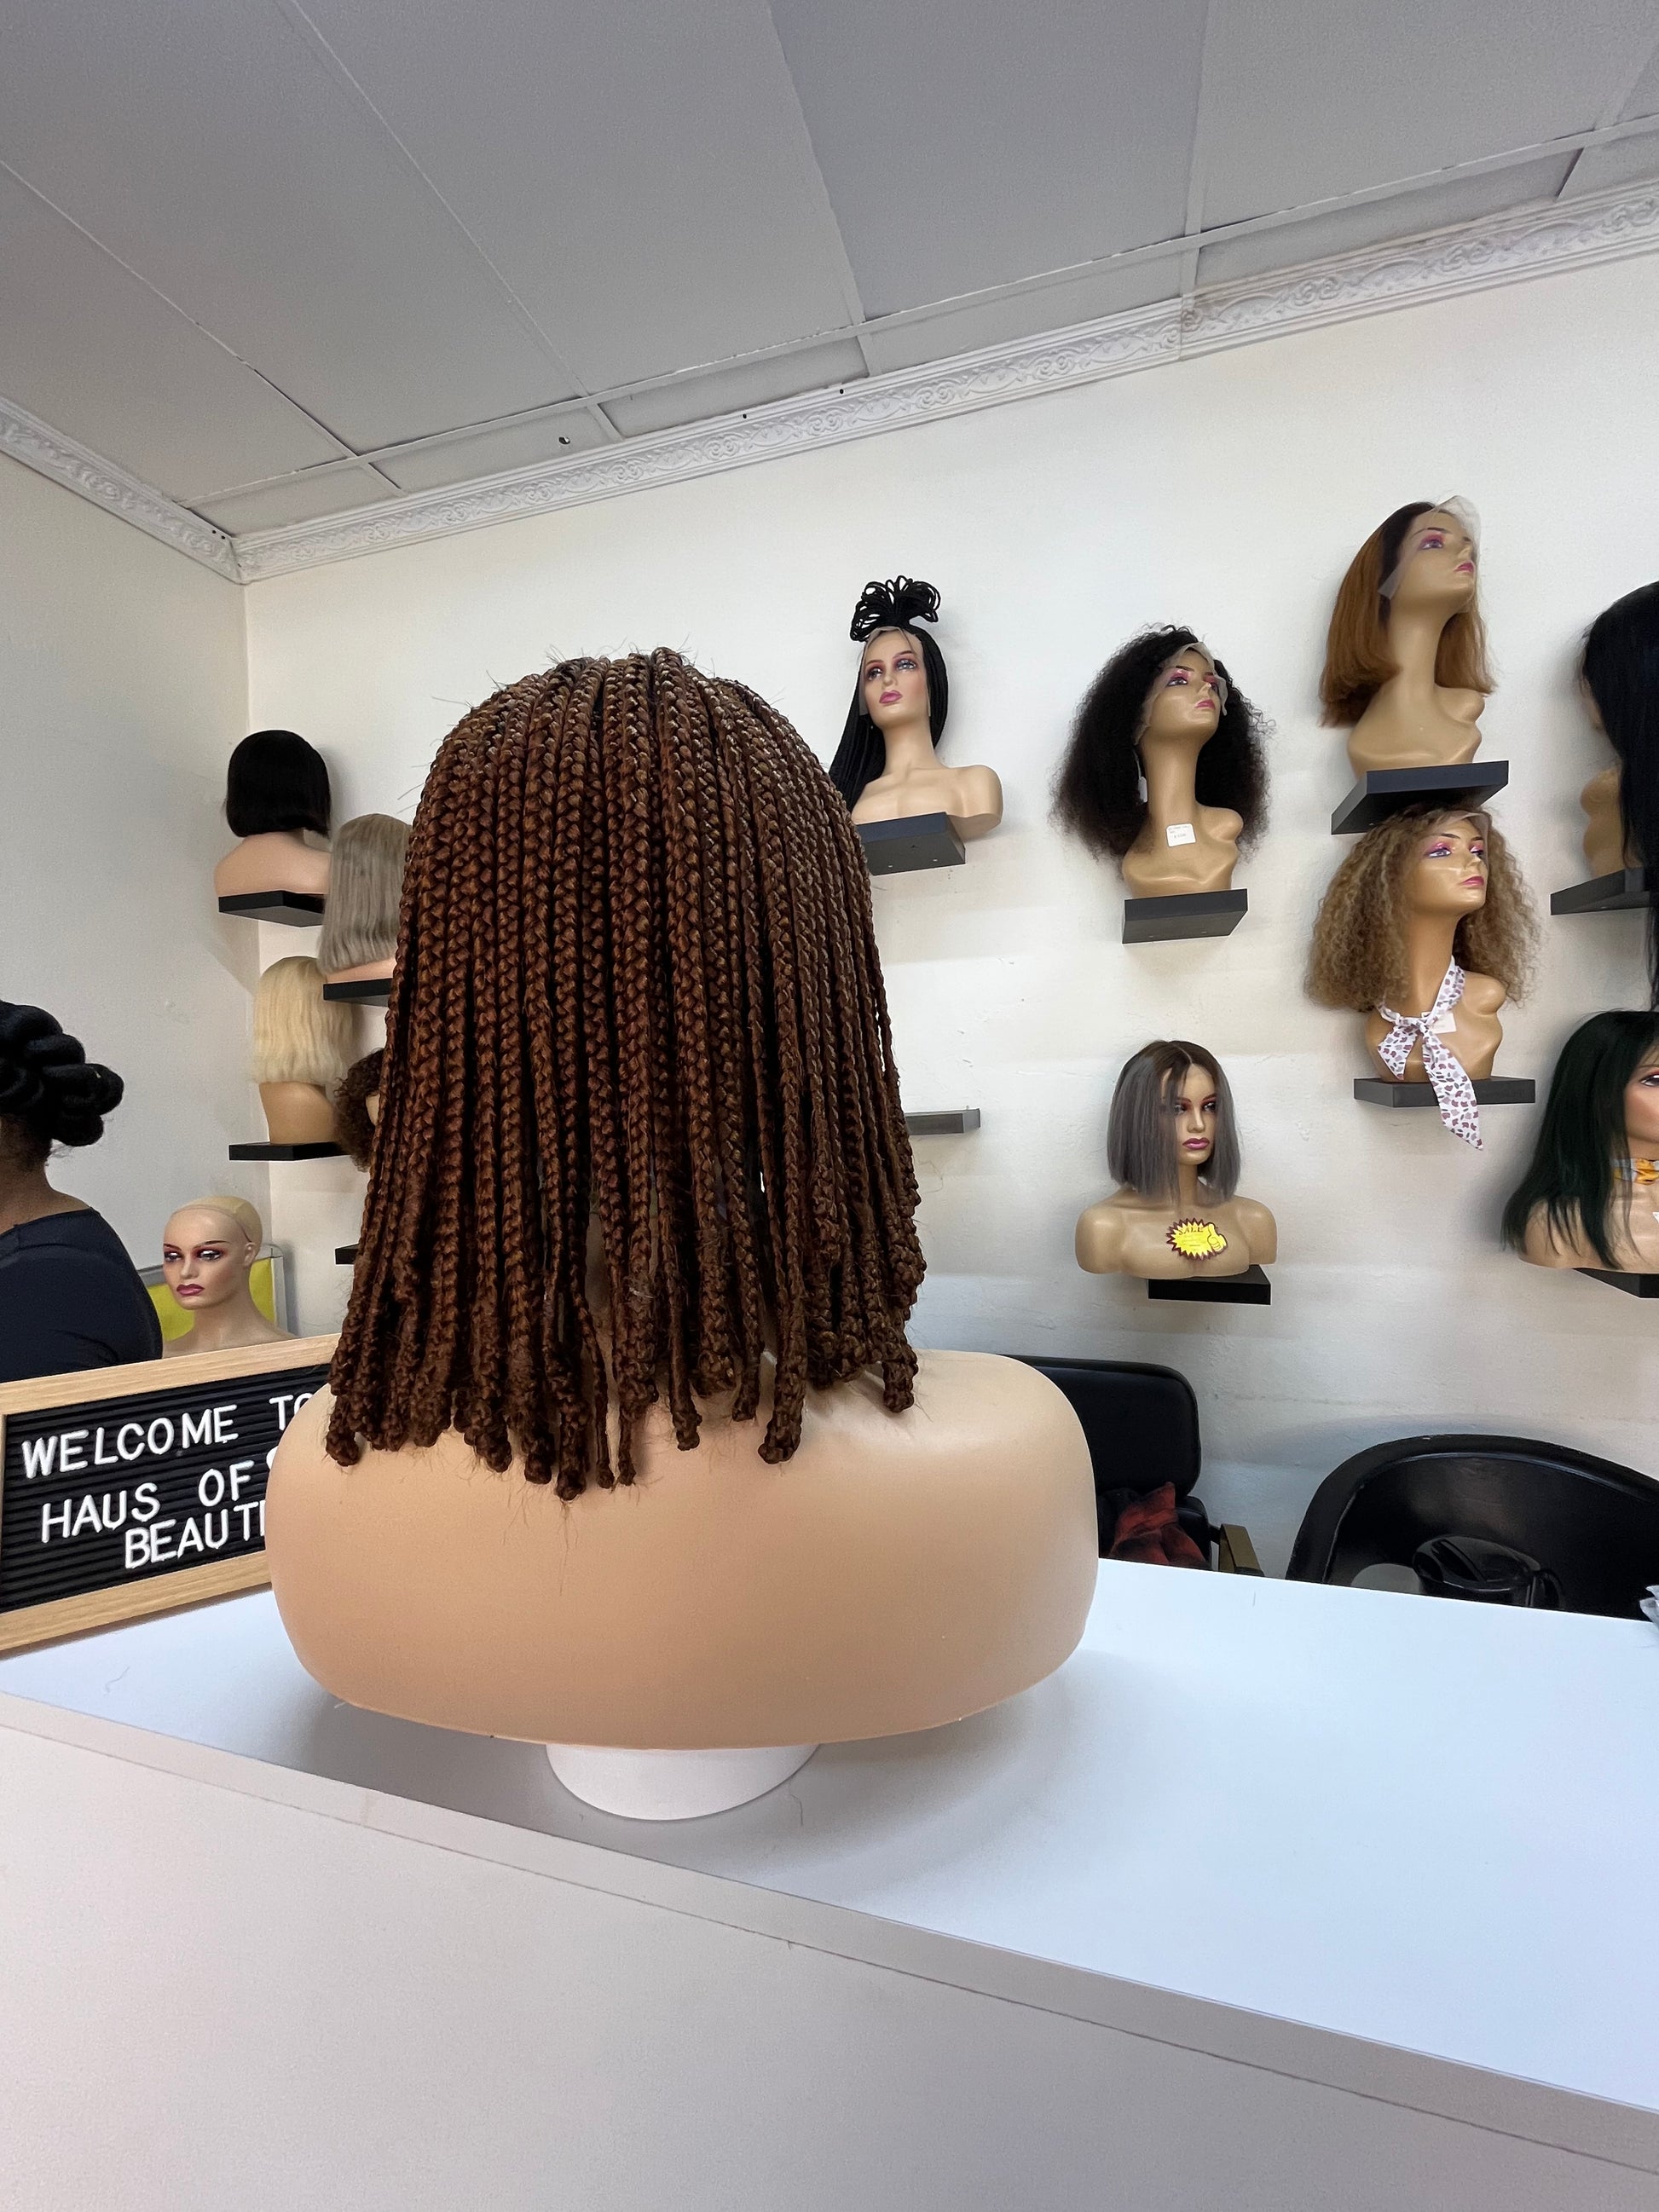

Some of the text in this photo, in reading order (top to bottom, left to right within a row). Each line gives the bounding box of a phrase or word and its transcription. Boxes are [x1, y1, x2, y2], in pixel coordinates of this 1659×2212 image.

[1178, 1227, 1204, 1235] SALE
[22, 1404, 239, 1479] WELCOME
[41, 1460, 255, 1544] HAUS OF
[124, 1499, 266, 1568] BEAUT
